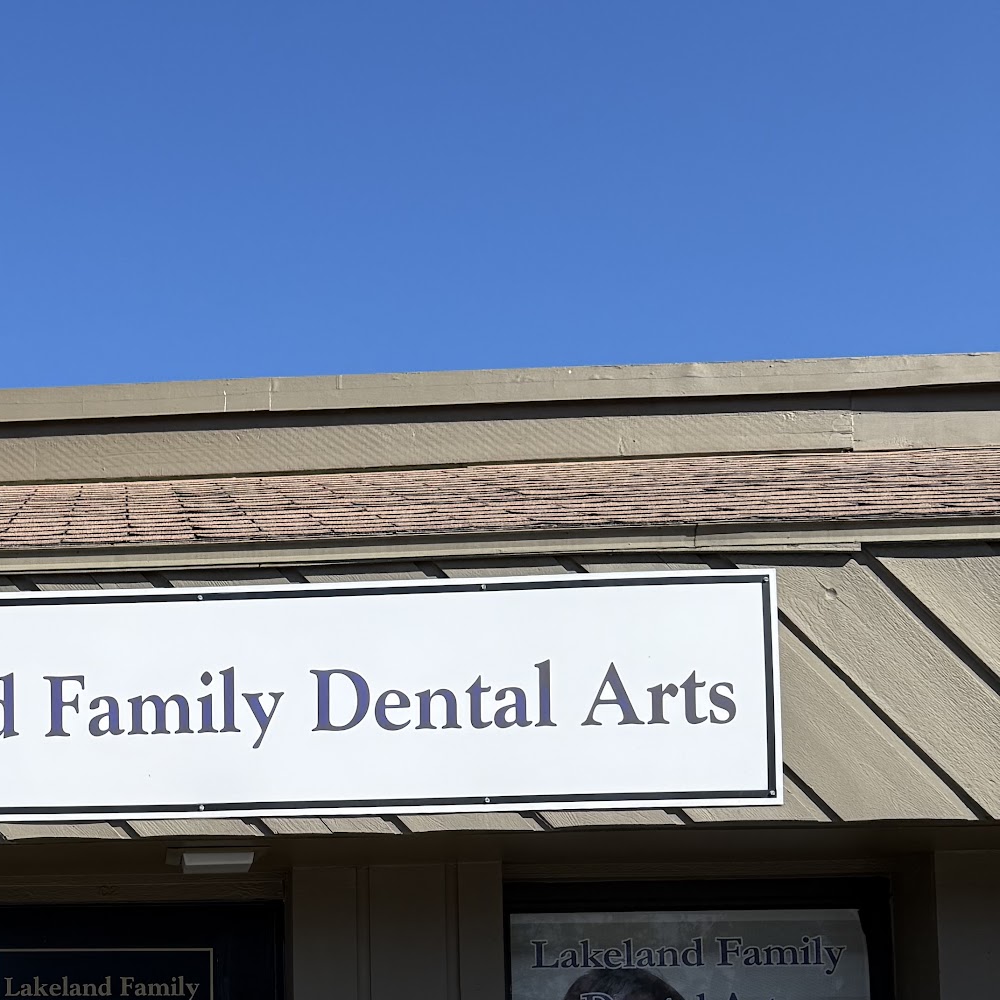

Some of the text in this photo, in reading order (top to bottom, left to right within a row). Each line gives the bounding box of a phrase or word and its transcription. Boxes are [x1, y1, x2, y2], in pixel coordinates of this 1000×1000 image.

[43, 666, 285, 749] Family
[310, 660, 557, 732] Dental
[581, 661, 736, 727] Arts
[530, 935, 847, 975] Lakeland Family
[4, 976, 200, 1000] Lakeland Family
